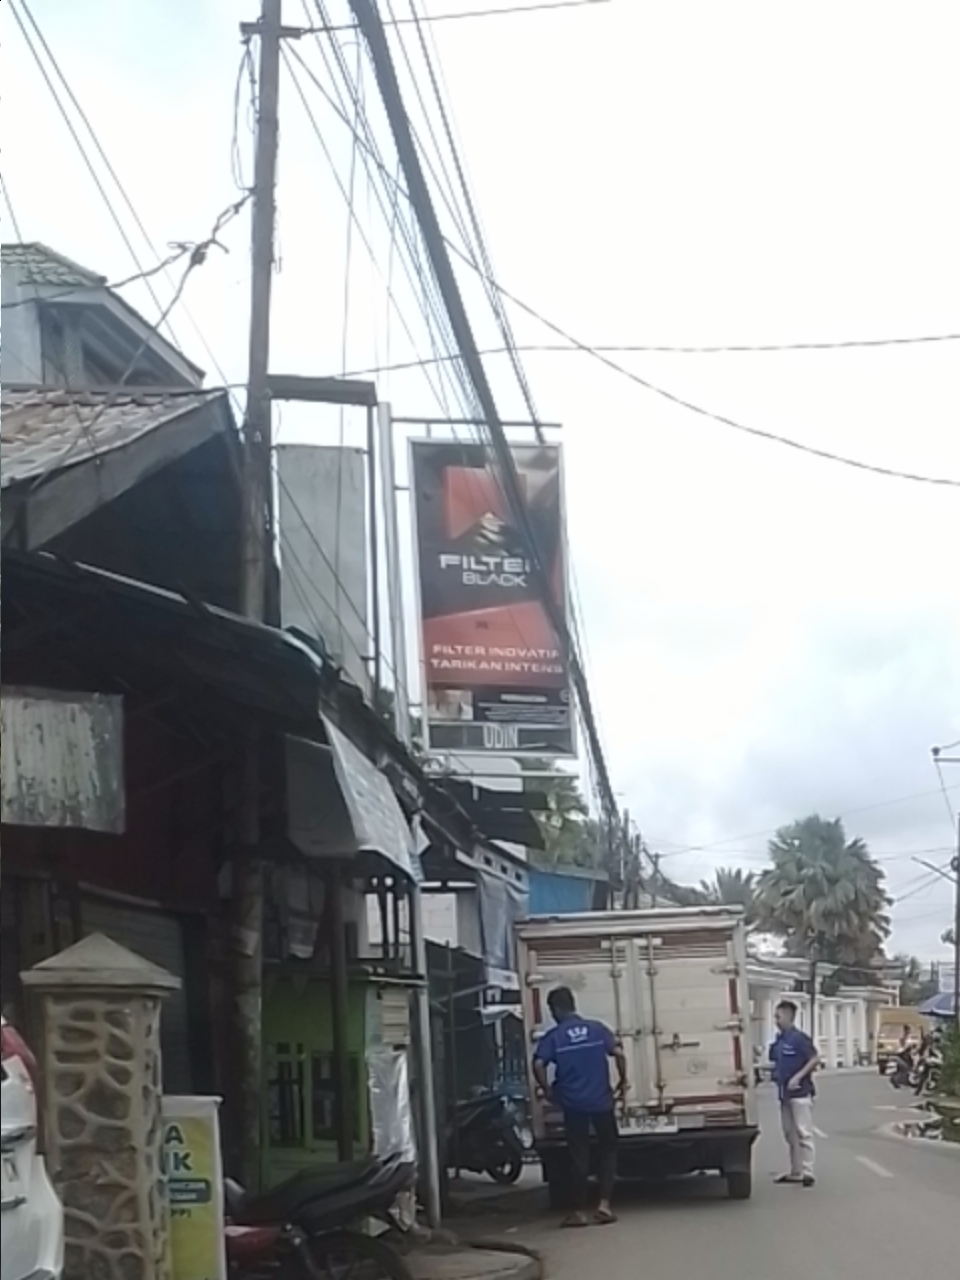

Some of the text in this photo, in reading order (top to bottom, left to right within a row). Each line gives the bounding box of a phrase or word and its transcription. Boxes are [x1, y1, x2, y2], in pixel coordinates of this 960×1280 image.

[462, 571, 528, 587] BLACK
[433, 643, 487, 656] FILTER
[430, 658, 564, 674] TARIKAN INTENS
